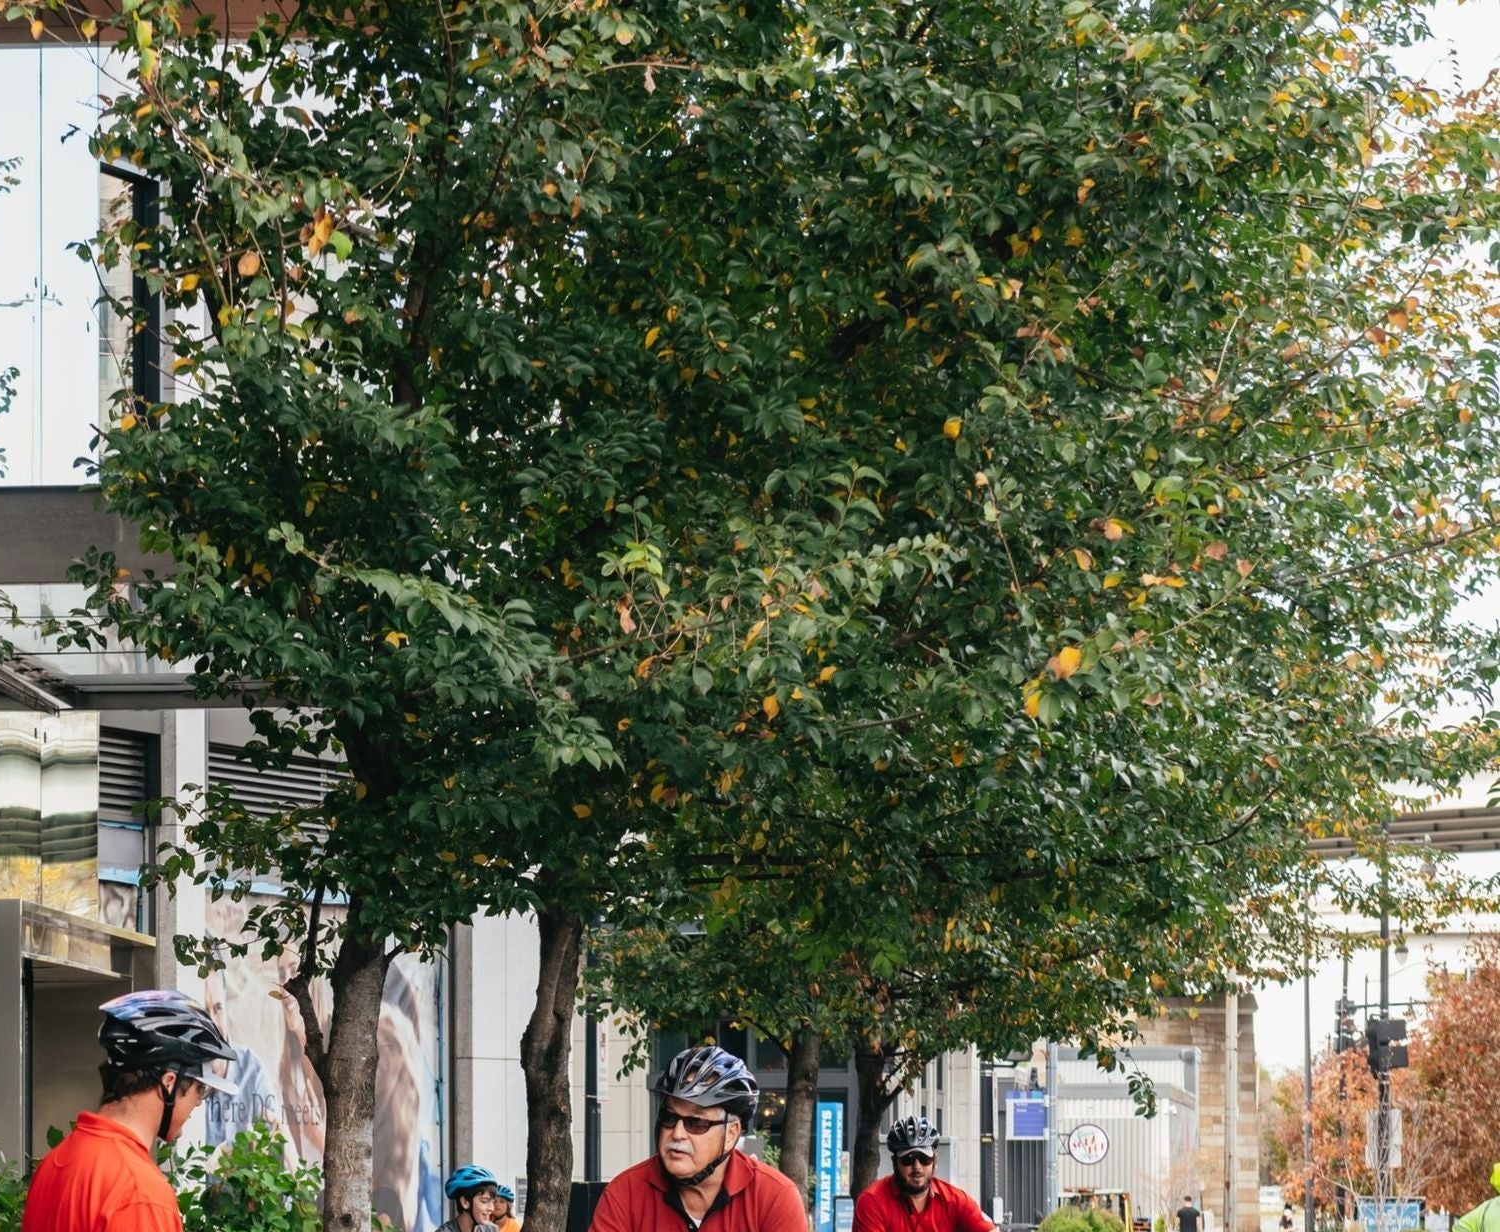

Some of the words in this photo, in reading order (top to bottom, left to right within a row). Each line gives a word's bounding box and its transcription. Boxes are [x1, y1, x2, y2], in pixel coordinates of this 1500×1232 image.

[251, 1093, 276, 1124] DC
[821, 1109, 832, 1168] EVENTS
[820, 1171, 831, 1224] WHARF
